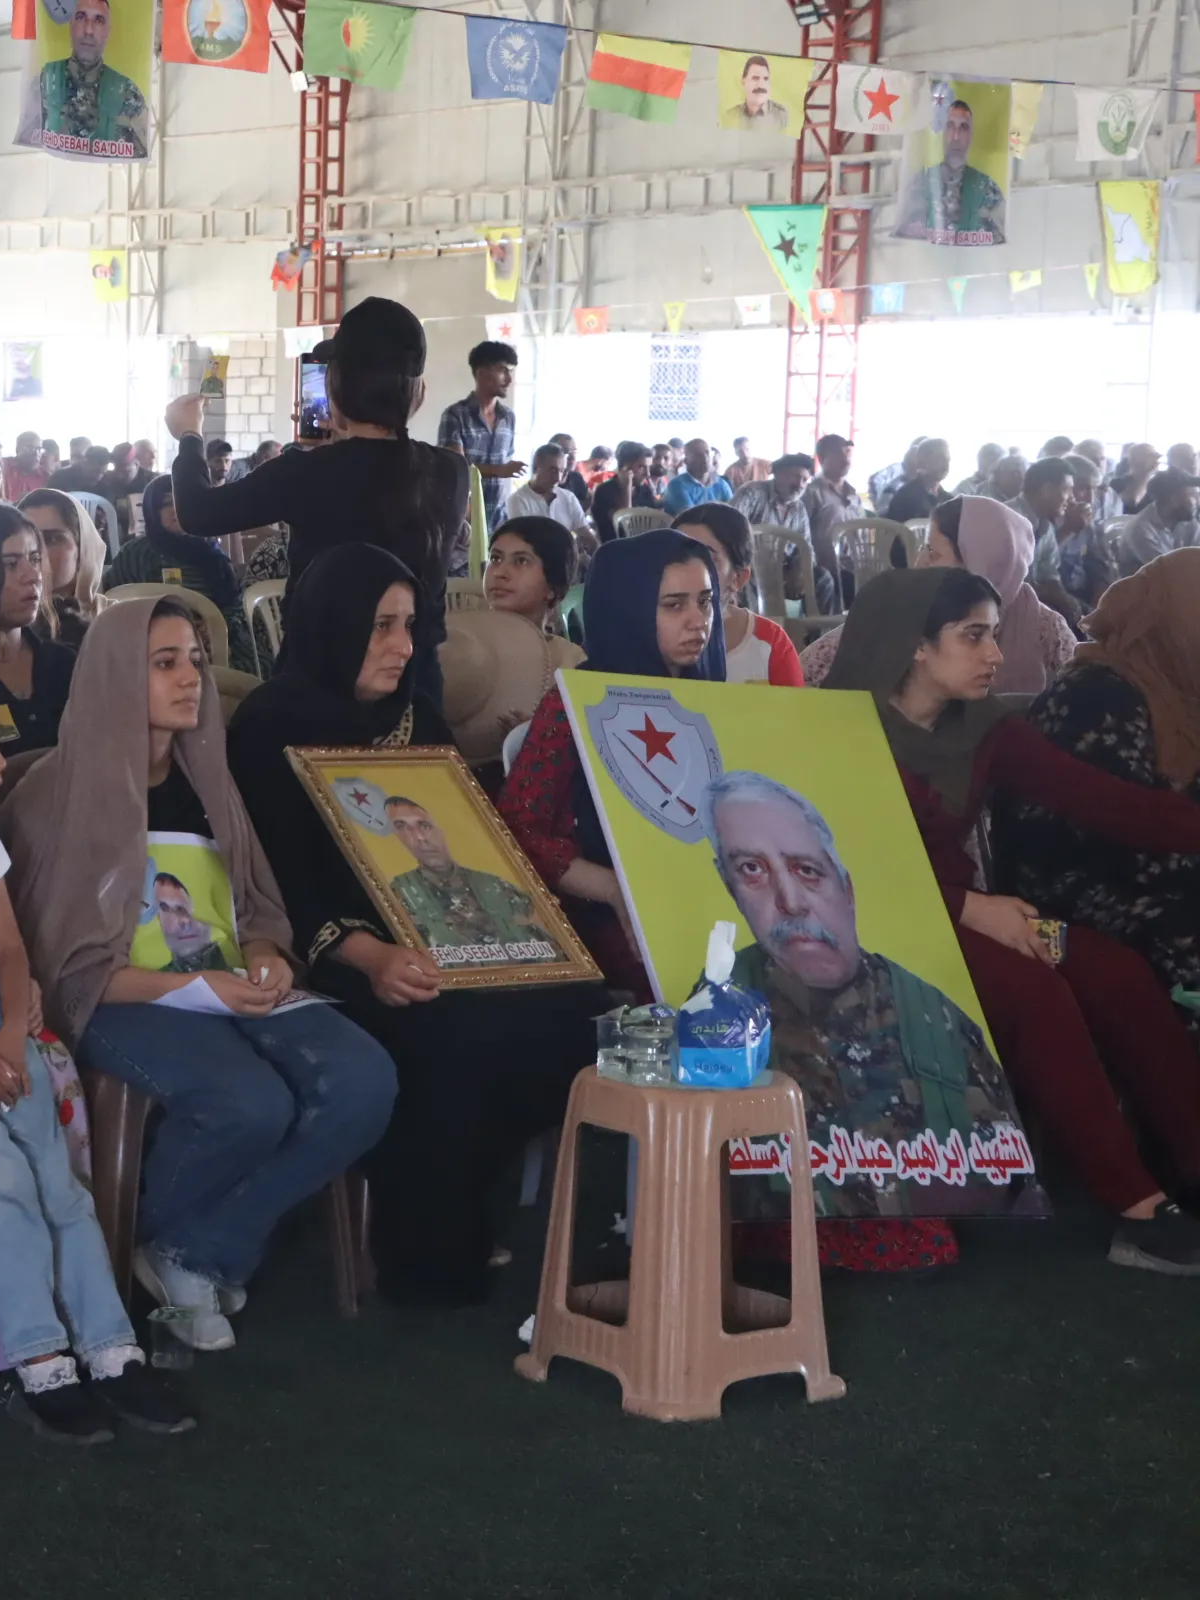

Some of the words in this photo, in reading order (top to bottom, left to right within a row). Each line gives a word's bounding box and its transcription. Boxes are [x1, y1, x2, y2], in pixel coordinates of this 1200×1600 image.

[59, 135, 89, 152] SEBAH
[93, 139, 133, 156] SA'DÛN
[462, 944, 506, 961] SEBAH
[506, 938, 556, 959] SA'DÛN
